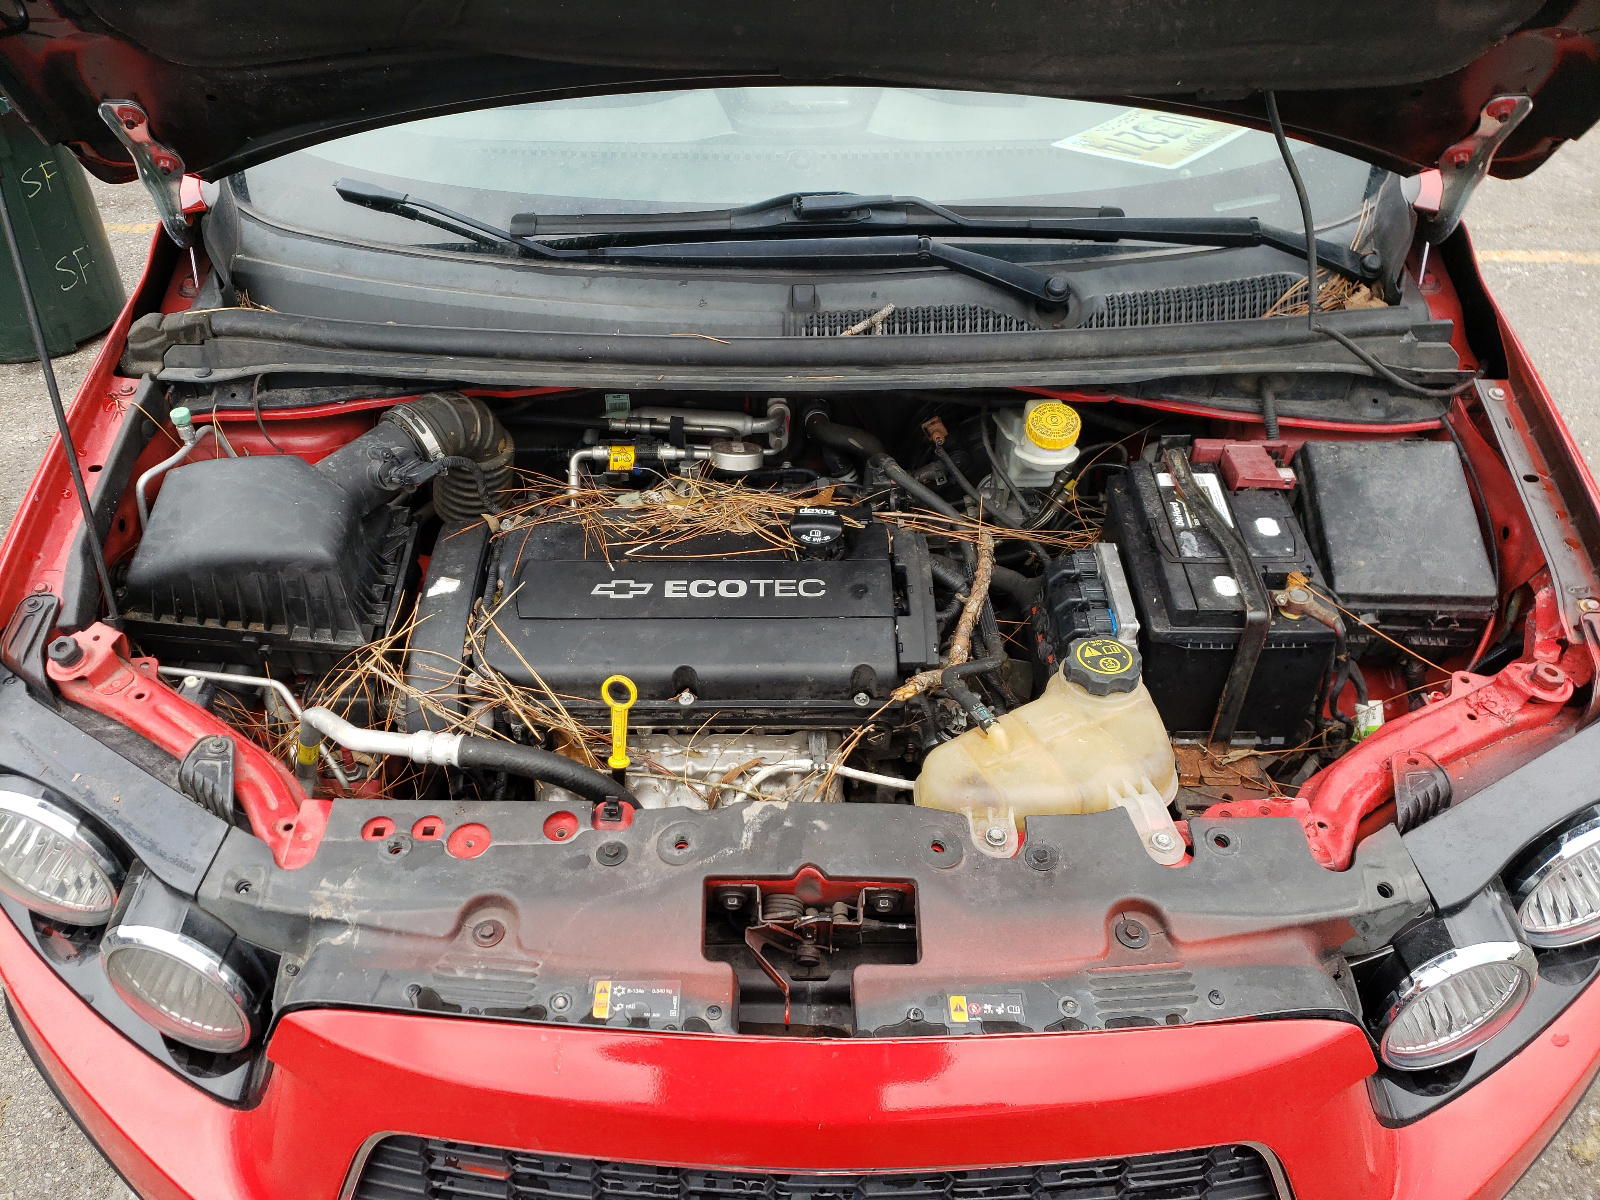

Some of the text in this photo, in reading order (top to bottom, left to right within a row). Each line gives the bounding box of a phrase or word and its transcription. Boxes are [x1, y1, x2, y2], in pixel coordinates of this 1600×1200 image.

[21, 160, 57, 198] SF
[55, 245, 90, 292] SF
[799, 507, 835, 515] dexos
[1169, 501, 1185, 527] DieHard
[664, 579, 826, 598] ECOTEC
